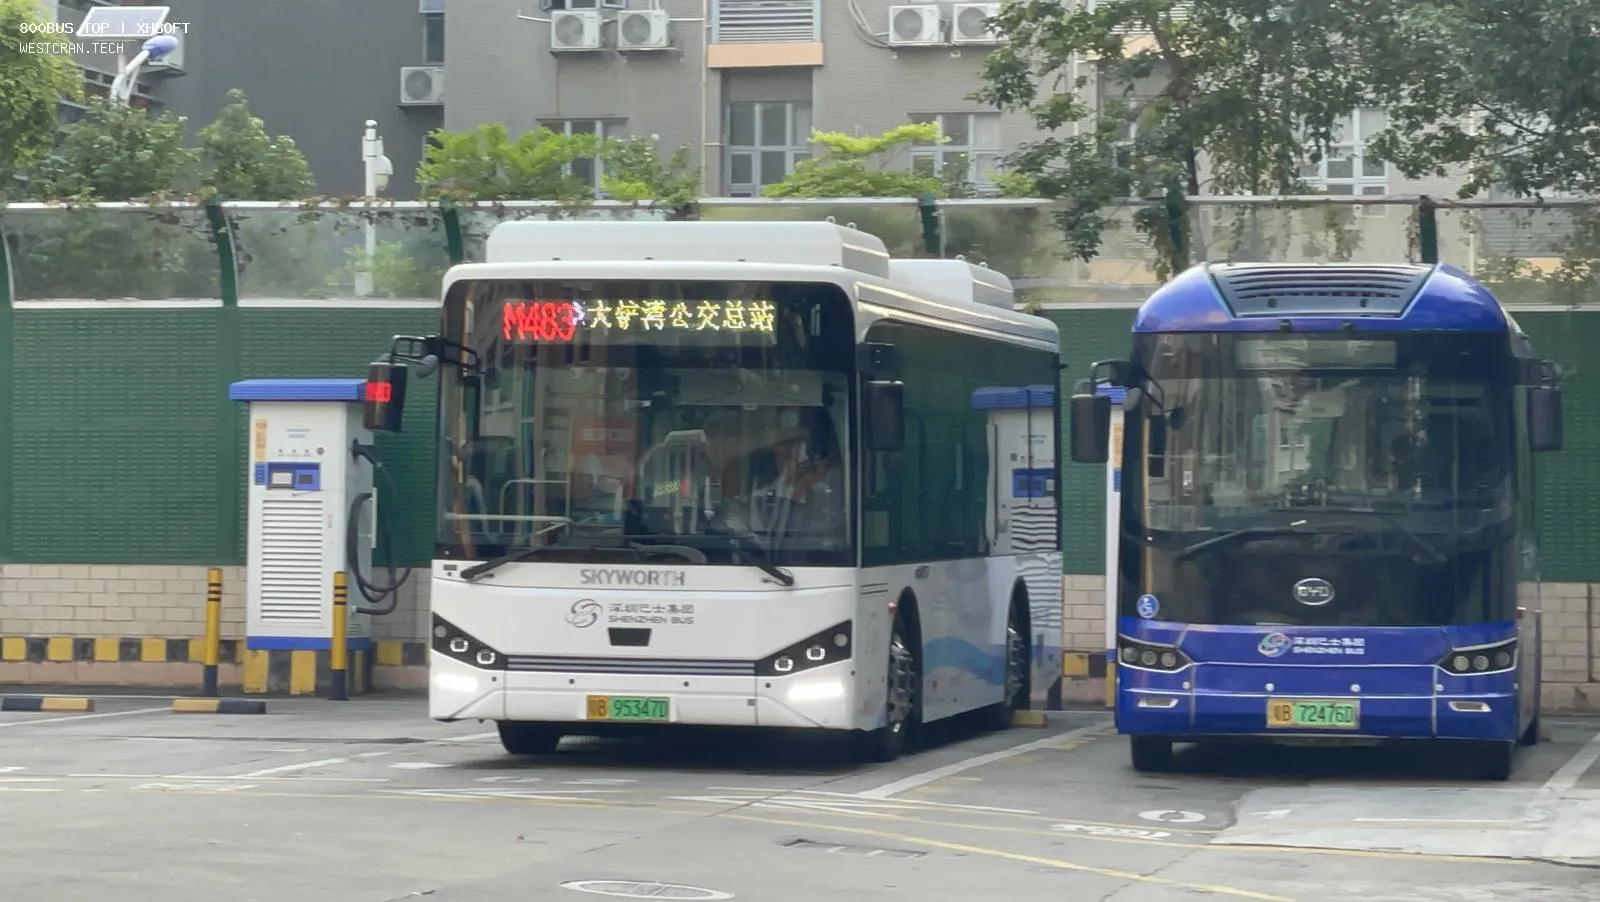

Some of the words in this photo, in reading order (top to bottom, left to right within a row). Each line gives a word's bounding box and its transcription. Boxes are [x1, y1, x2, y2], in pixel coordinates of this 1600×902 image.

[503, 302, 576, 341] M483
[580, 569, 685, 586] SKYWORTH
[608, 615, 667, 624] SHENZHEN
[671, 616, 694, 625] BUS
